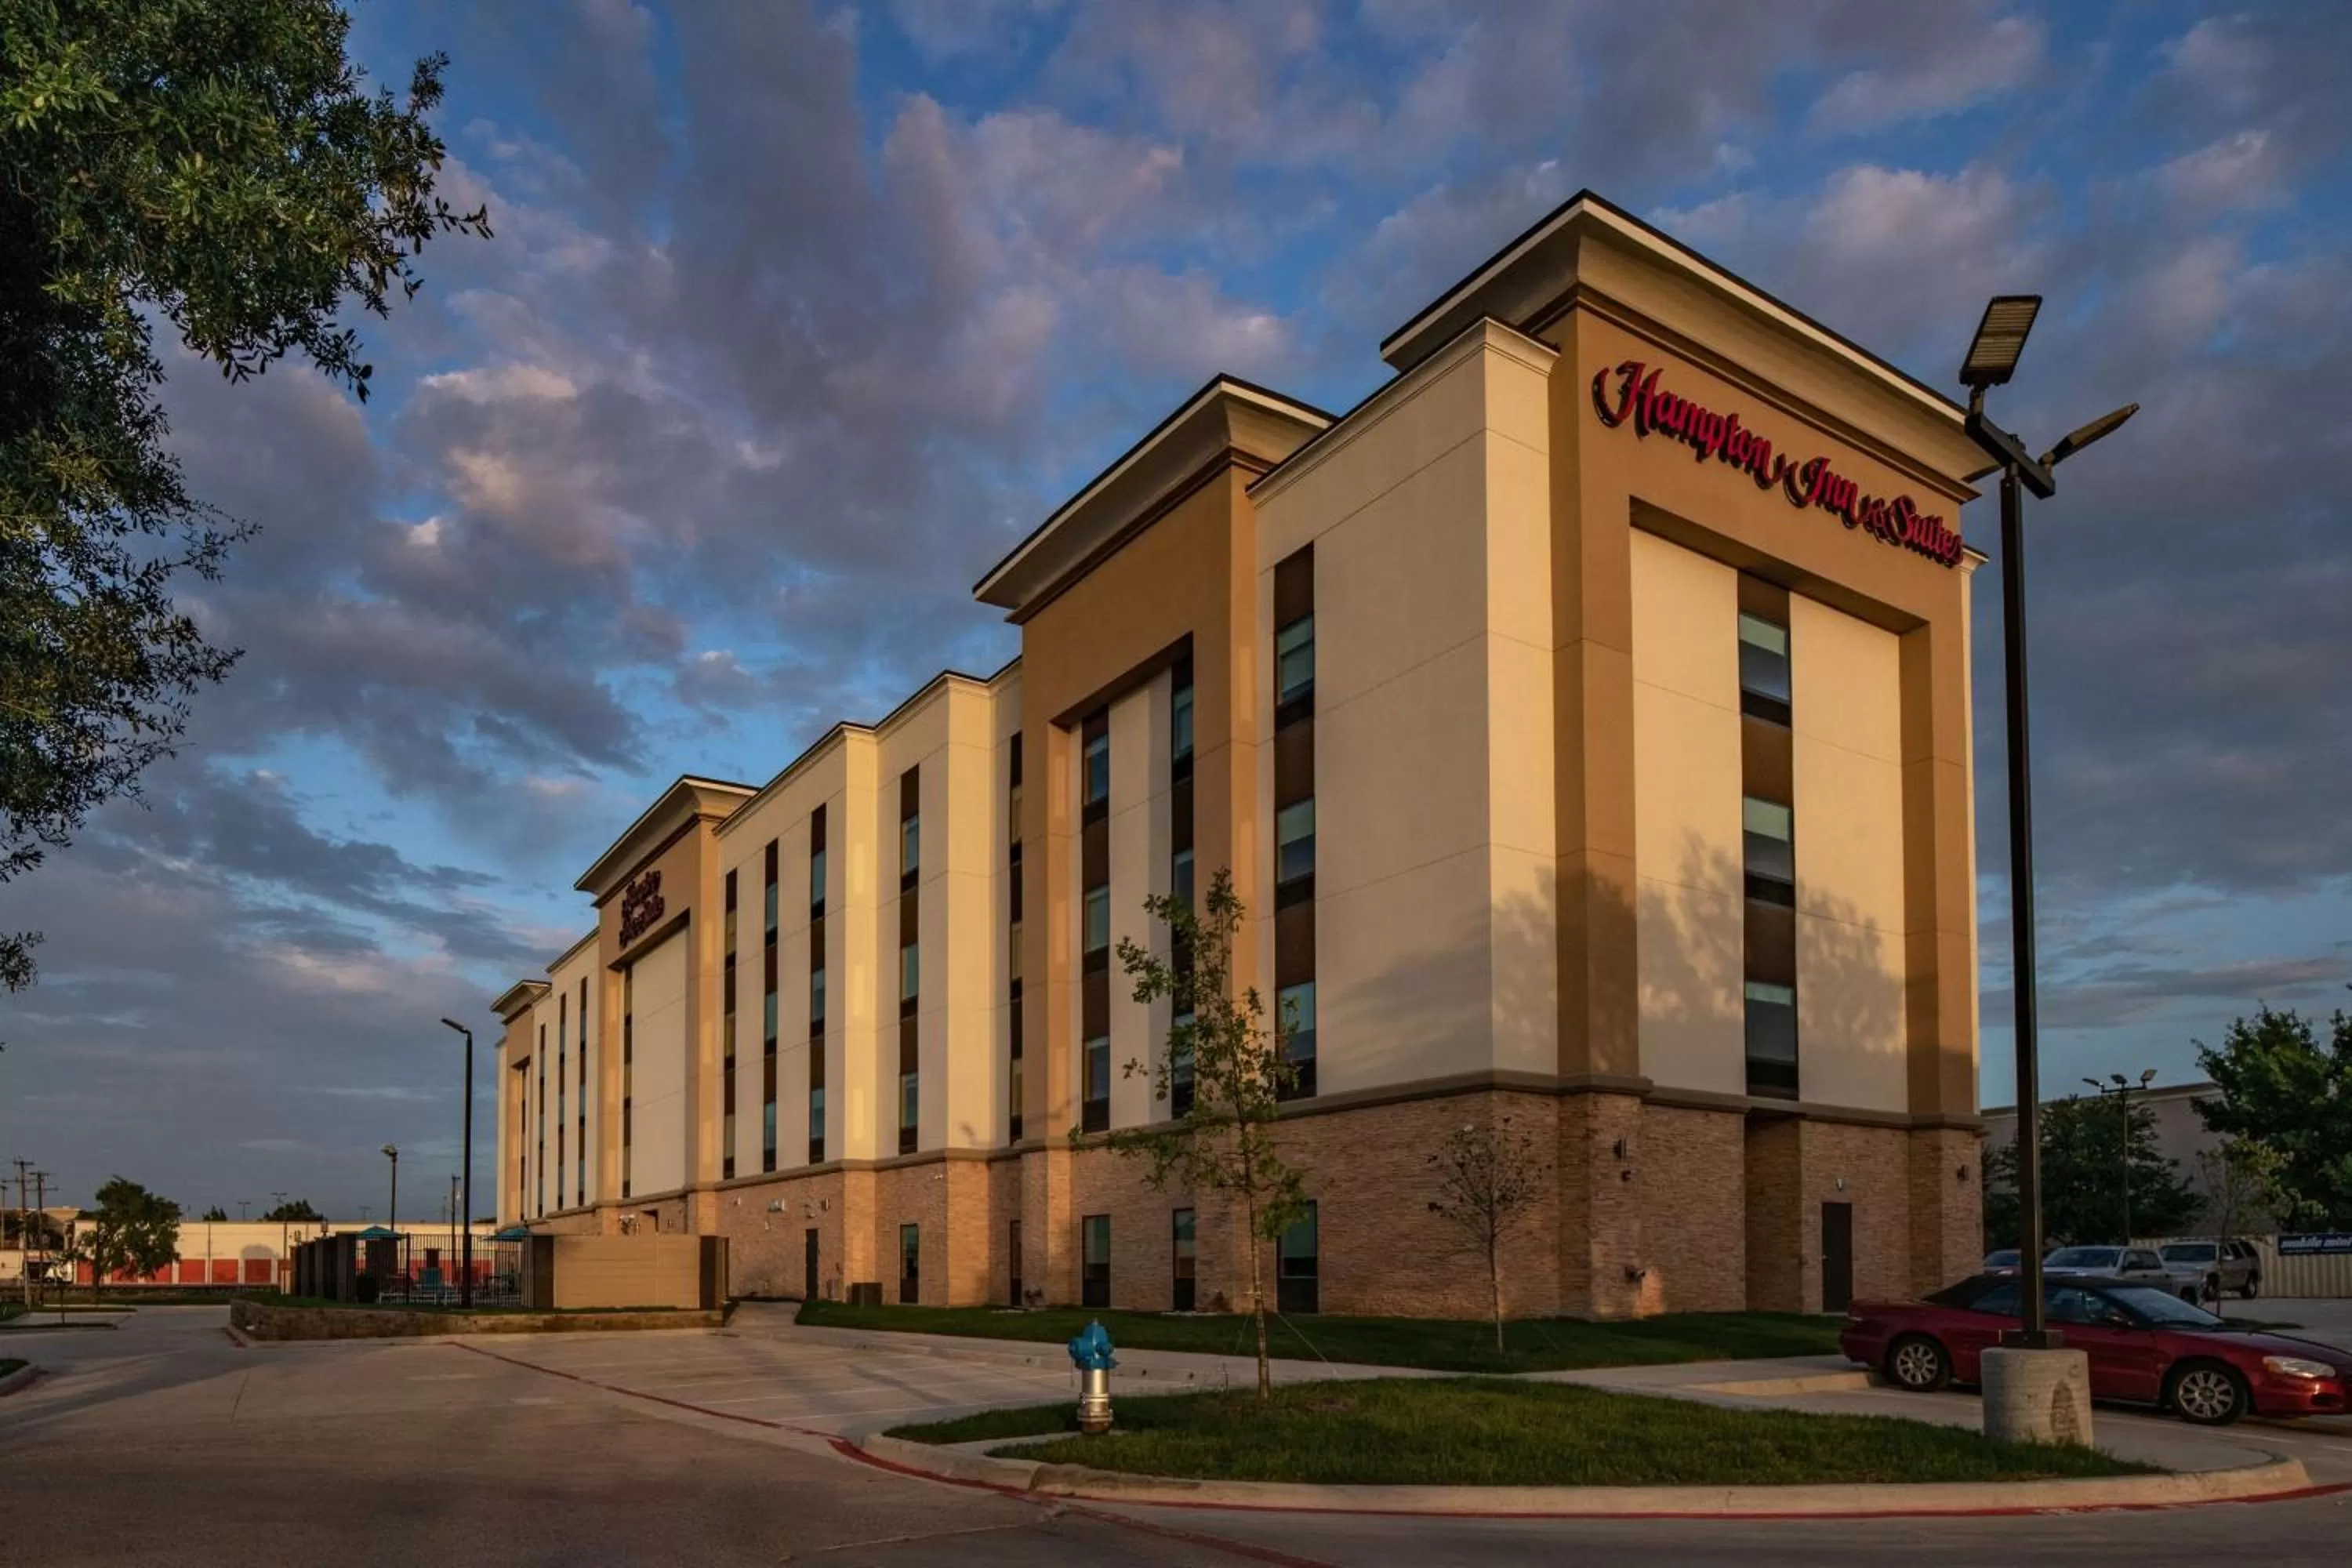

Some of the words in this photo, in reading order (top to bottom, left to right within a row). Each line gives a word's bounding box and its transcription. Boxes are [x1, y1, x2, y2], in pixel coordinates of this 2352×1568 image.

[1592, 360, 1785, 490] Hampton
[1782, 456, 1871, 529] Inn
[1883, 494, 1964, 568] Suites
